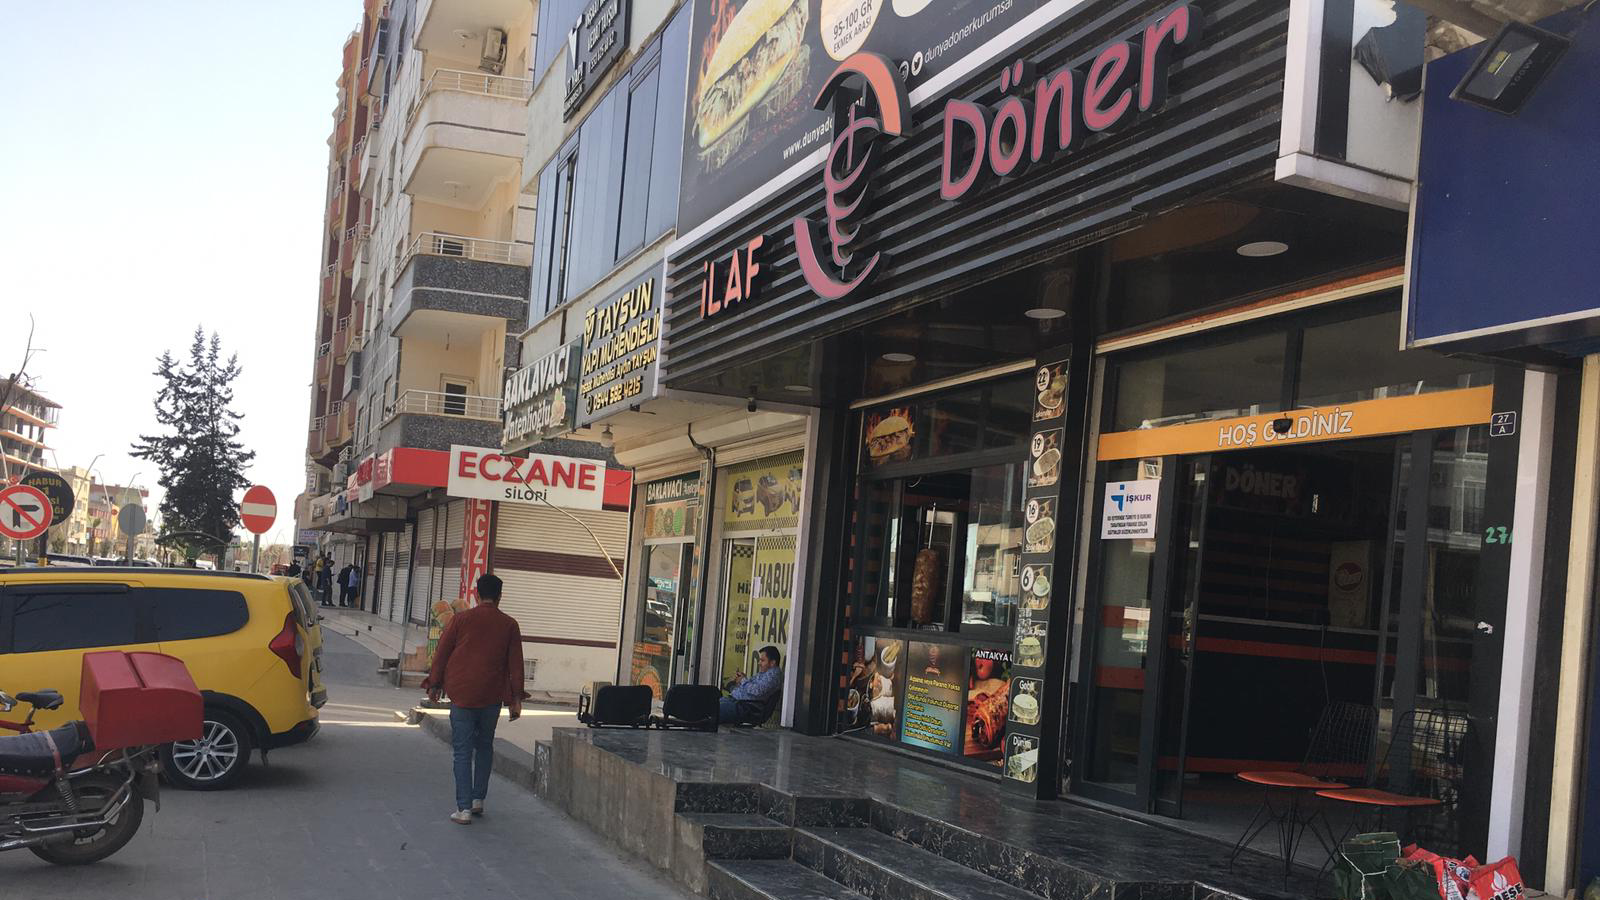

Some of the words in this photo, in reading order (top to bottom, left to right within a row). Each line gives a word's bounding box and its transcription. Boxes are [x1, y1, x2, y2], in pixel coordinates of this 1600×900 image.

[833, 9, 859, 40] 95-100
[860, 1, 873, 17] GR
[833, 33, 853, 53] EKMEK
[853, 16, 872, 36] ARASI
[940, 5, 1190, 200] Döner
[582, 347, 600, 376] YAPI
[503, 344, 571, 412] BAKLAVACI
[1218, 423, 1257, 446] HOŞ
[1263, 408, 1353, 441] GLDİNİZ
[1497, 414, 1509, 424] 27
[1498, 425, 1506, 434] A
[458, 451, 597, 491] ECZANE
[1225, 464, 1297, 498] DÖNER
[505, 486, 547, 501] SİLOPİ
[647, 479, 683, 501] BAKLAVACI
[1126, 493, 1152, 504] İŞKUR
[975, 650, 1009, 662] ANTAKYA
